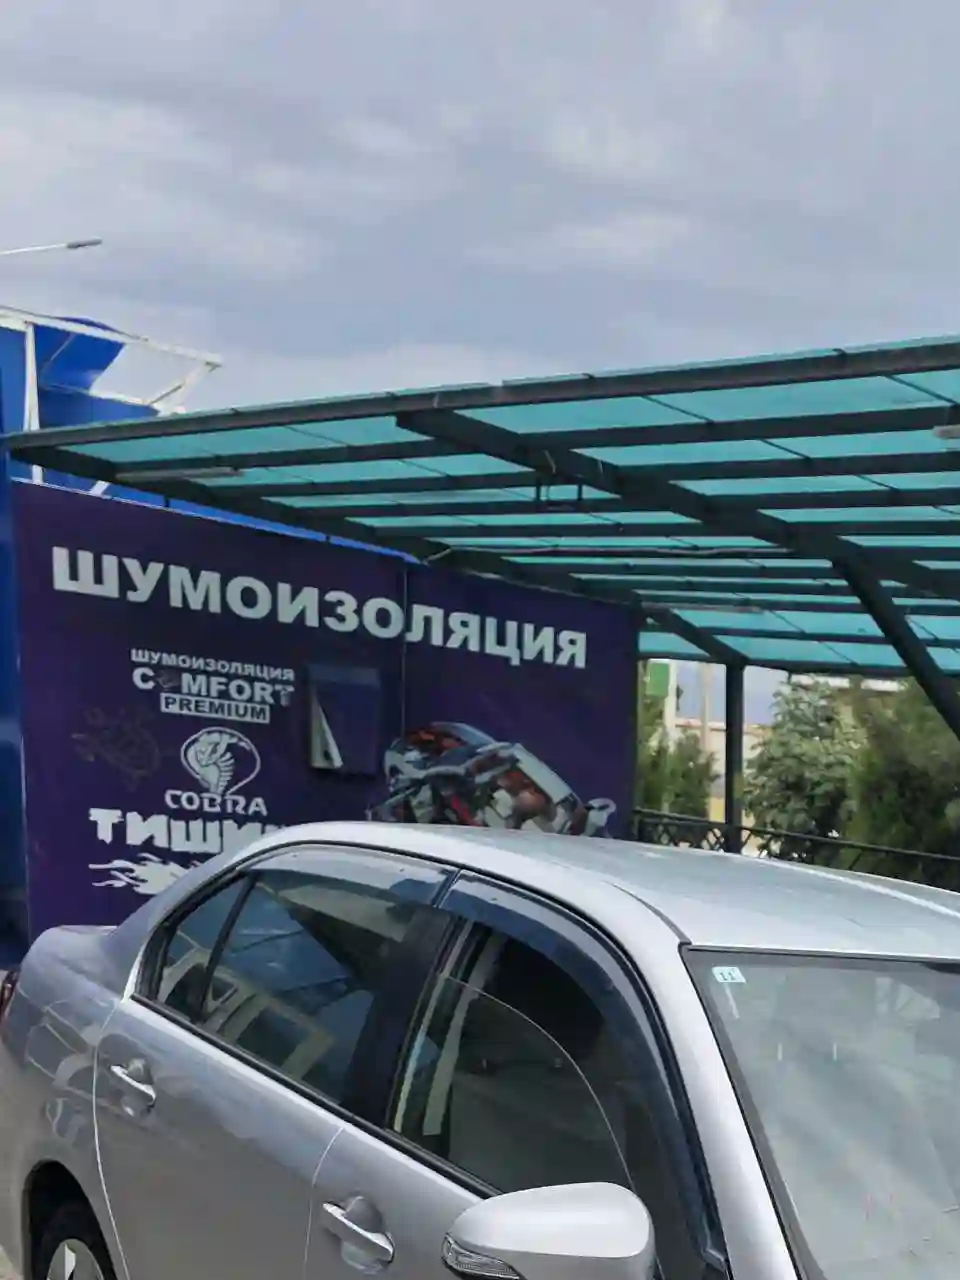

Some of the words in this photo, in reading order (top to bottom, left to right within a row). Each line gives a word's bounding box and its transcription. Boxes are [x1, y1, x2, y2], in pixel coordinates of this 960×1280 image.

[52, 546, 587, 668] ШУМОИЗОЛЯЦИЯ
[130, 648, 295, 681] ШУМОИЗОЛЯЦИЯ
[132, 667, 295, 706] CMFORT
[164, 696, 267, 721] PREMIUM
[165, 789, 267, 816] COBRA
[88, 807, 287, 854] ТИШИ
